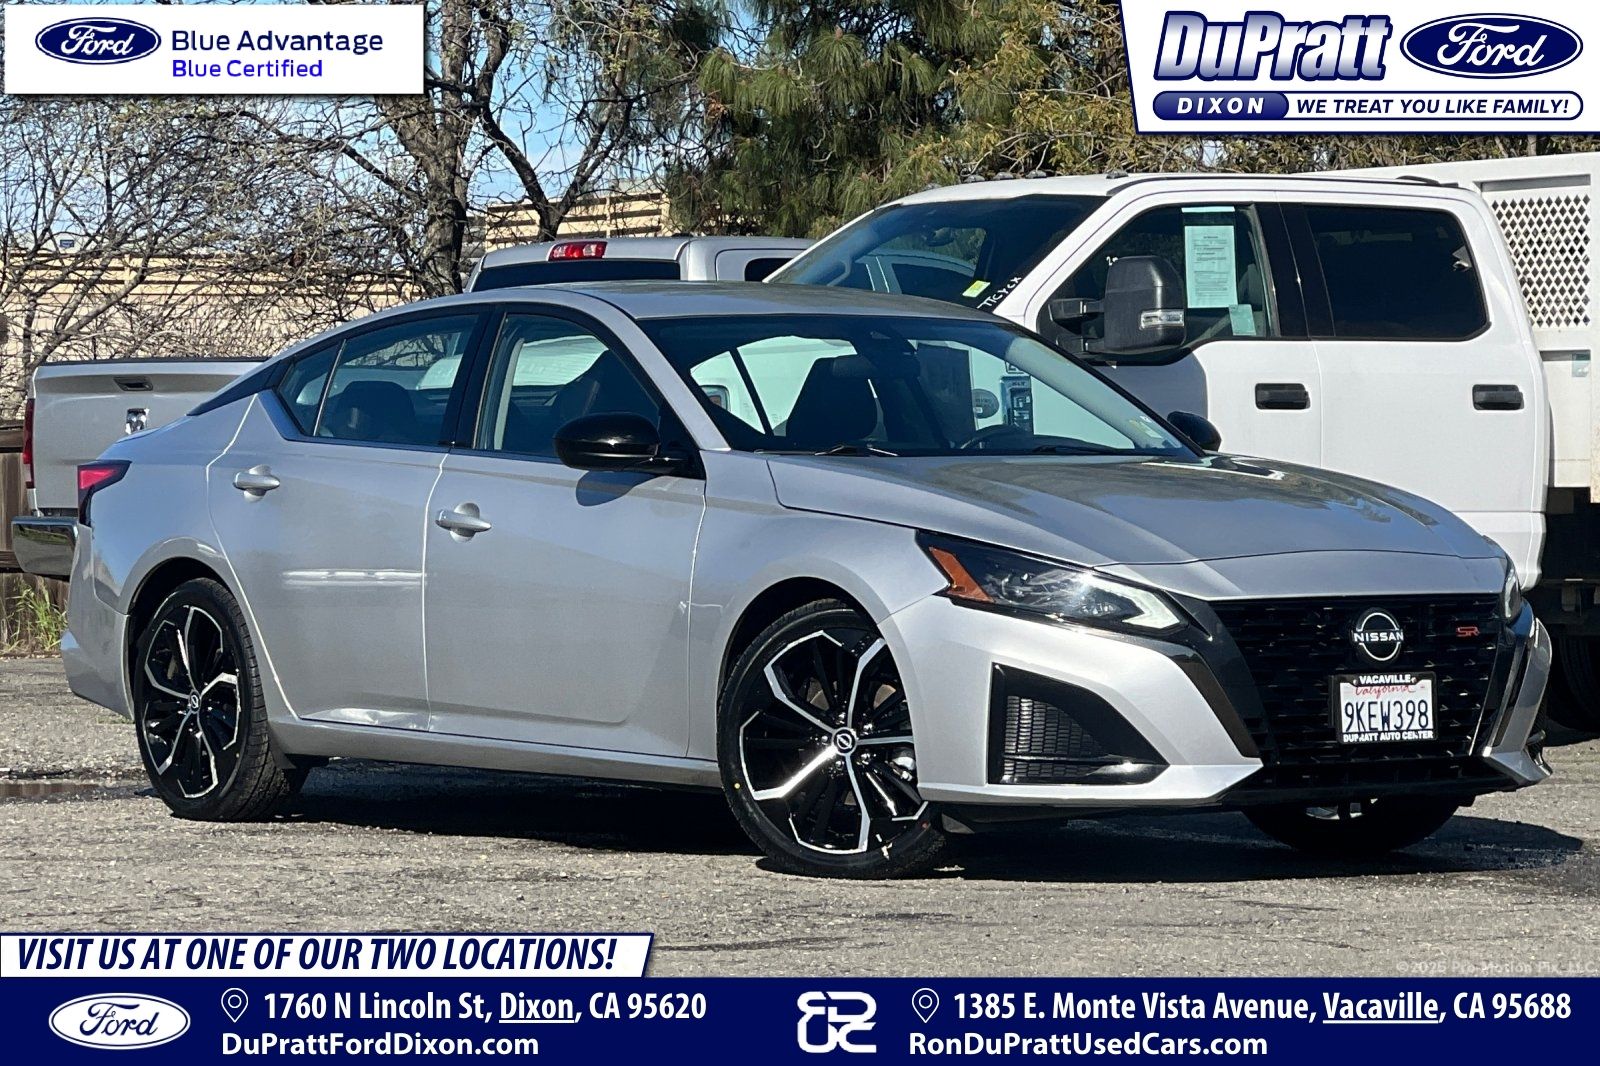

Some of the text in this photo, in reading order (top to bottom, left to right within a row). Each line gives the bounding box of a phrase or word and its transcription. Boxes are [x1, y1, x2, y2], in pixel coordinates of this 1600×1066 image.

[1353, 631, 1404, 642] NISSAN
[1455, 626, 1480, 637] SR
[1359, 674, 1411, 684] VACAVILLE
[1344, 699, 1429, 732] 9KEW398
[1380, 731, 1401, 741] AUTO
